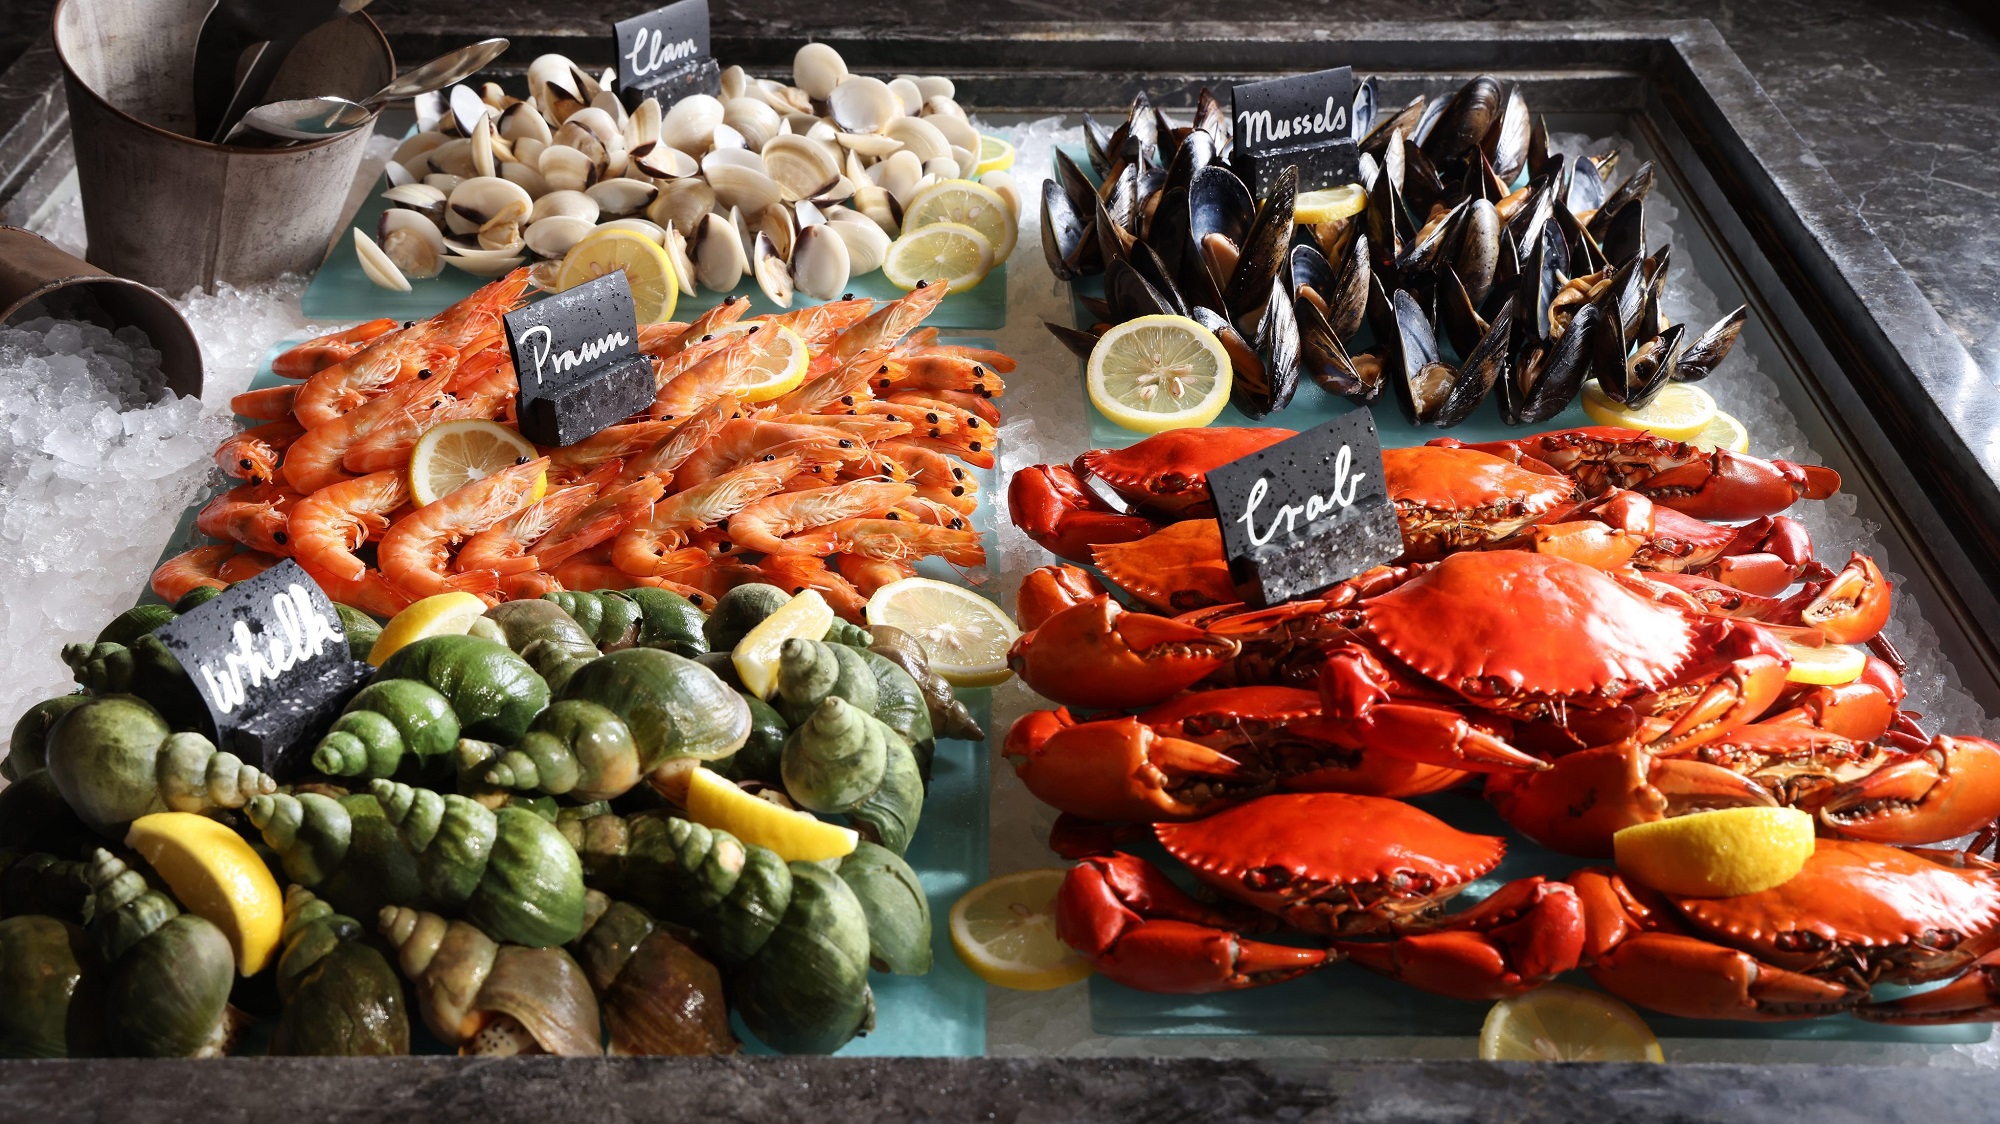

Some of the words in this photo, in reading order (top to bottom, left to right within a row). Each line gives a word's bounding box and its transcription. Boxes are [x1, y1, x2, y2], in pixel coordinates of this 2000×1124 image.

[625, 27, 697, 77] Clam
[1238, 97, 1346, 147] Mussels
[518, 325, 629, 384] Prawn
[1237, 445, 1366, 547] Crab
